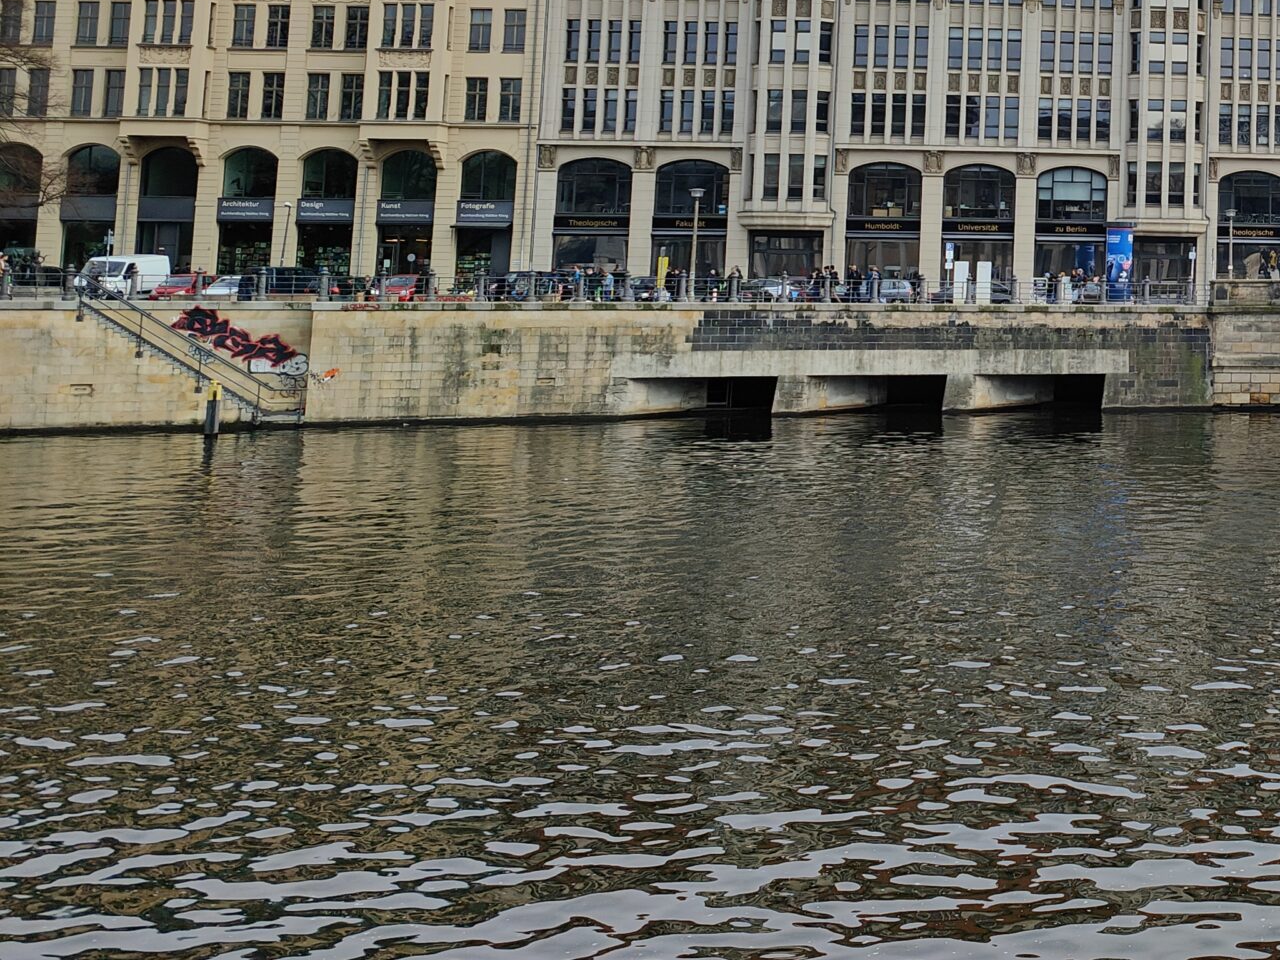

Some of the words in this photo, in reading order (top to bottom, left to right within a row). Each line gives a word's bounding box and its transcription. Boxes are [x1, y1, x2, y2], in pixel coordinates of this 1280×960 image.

[221, 200, 260, 208] Architektur
[301, 201, 324, 209] Design
[460, 202, 495, 210] Fotografie
[568, 219, 618, 227] Theologische
[675, 219, 706, 227] Fakuät
[865, 222, 903, 230] Humboldt-
[958, 223, 999, 232] Universität
[1066, 225, 1088, 233] Berlin
[1231, 228, 1274, 237] heologische
